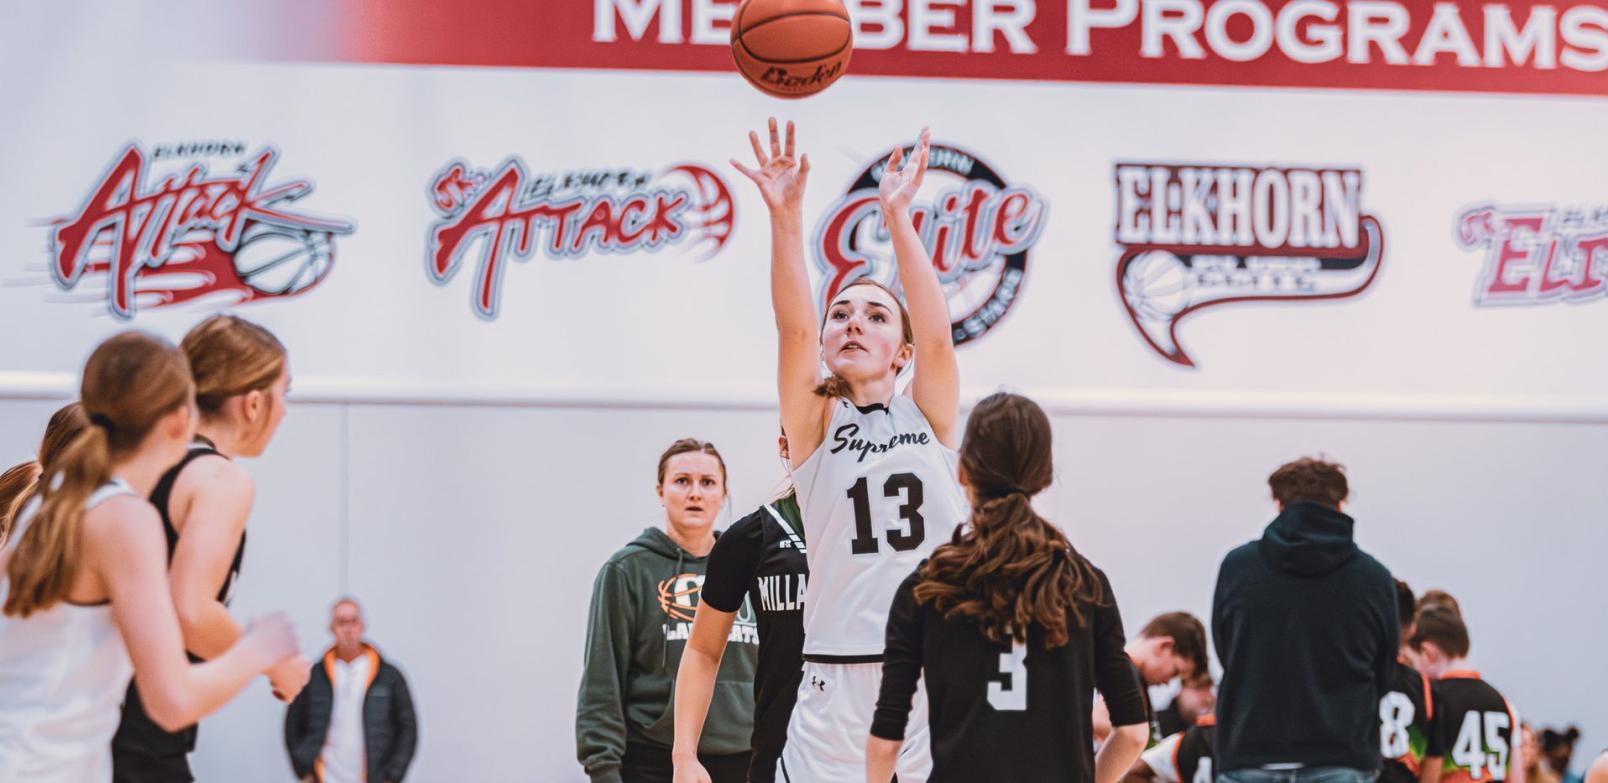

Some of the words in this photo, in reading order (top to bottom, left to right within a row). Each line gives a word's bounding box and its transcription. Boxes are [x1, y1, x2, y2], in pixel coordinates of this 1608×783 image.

[591, 0, 1038, 54] MEBER
[1065, 0, 1608, 71] PROGRAMS
[1116, 165, 1360, 249] ELKHORN
[830, 423, 930, 462] Supreme
[846, 472, 925, 555] 13
[757, 573, 808, 612] MILLA
[986, 625, 1028, 711] 3
[1451, 709, 1510, 781] 45
